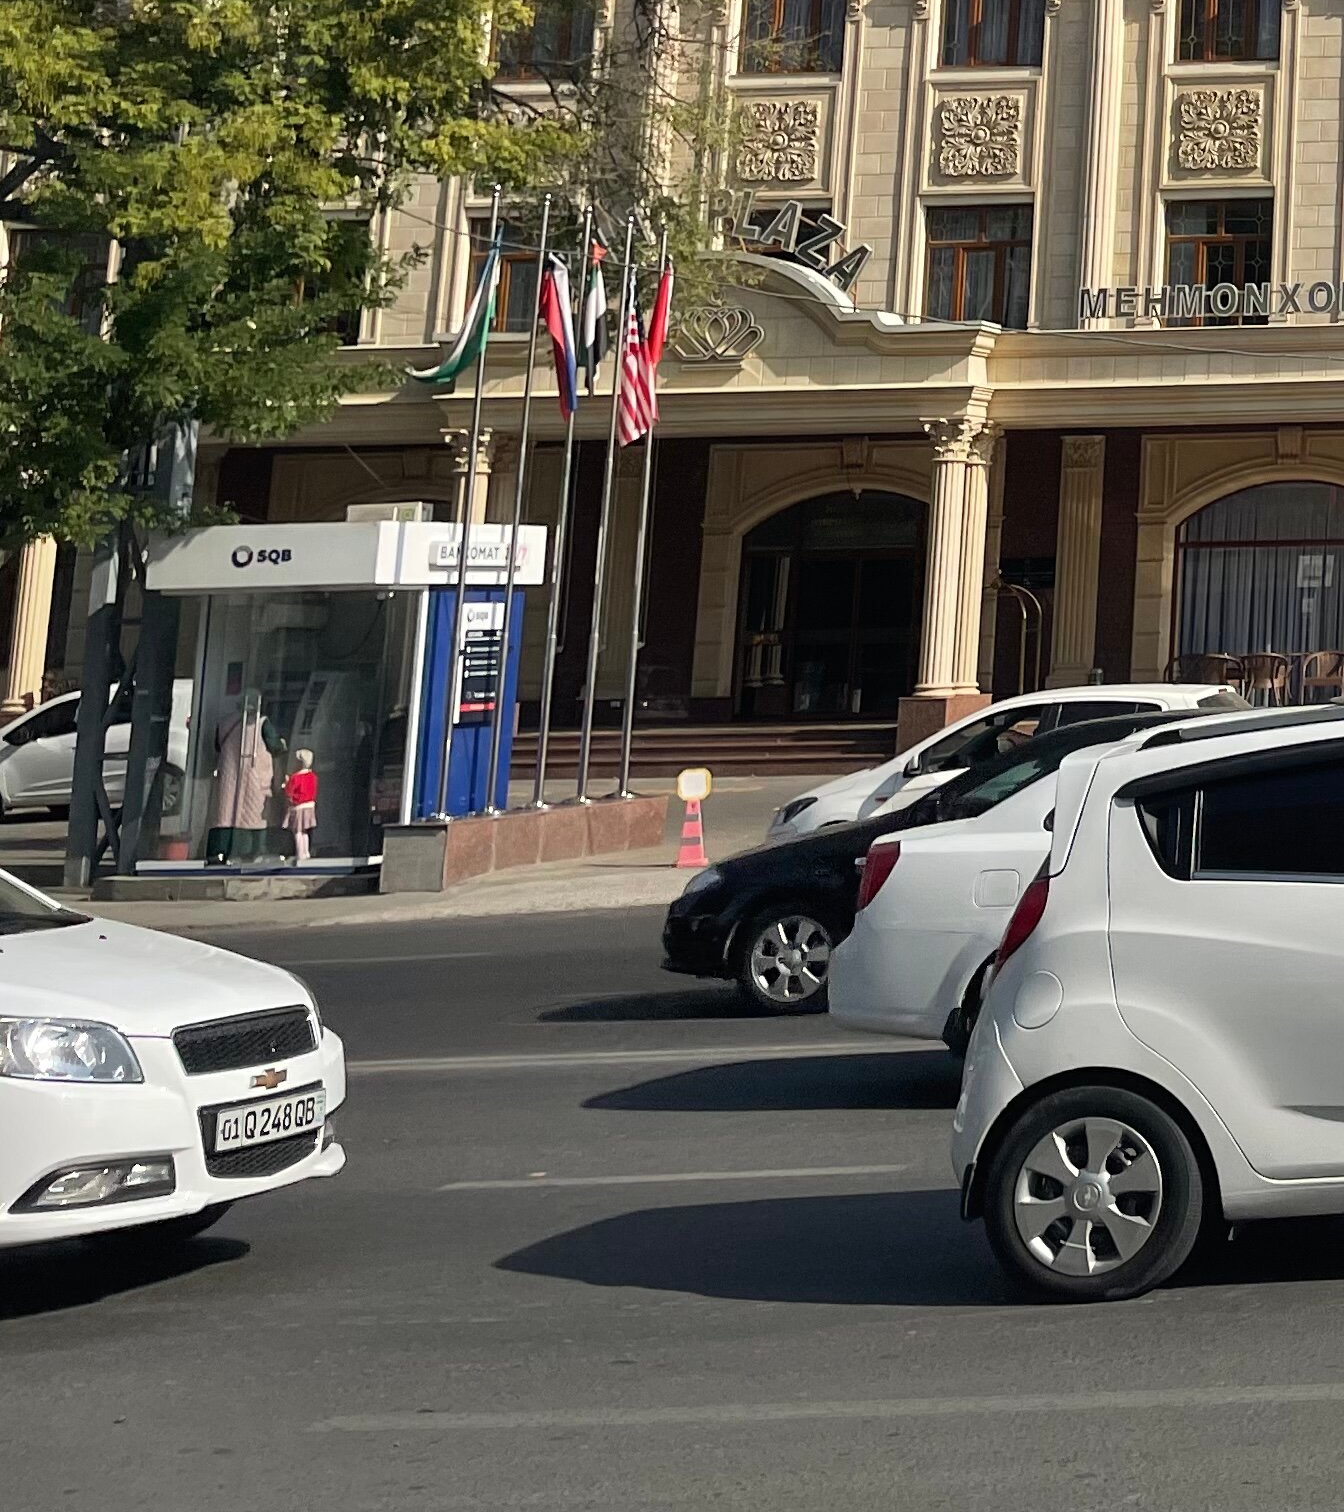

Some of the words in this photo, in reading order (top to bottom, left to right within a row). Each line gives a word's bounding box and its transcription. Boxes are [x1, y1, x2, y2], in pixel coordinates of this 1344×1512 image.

[707, 188, 873, 292] PLAZA
[257, 549, 292, 565] SQB
[440, 546, 500, 561] BAOMAT
[221, 1118, 240, 1142] 01
[260, 1102, 292, 1137] 248
